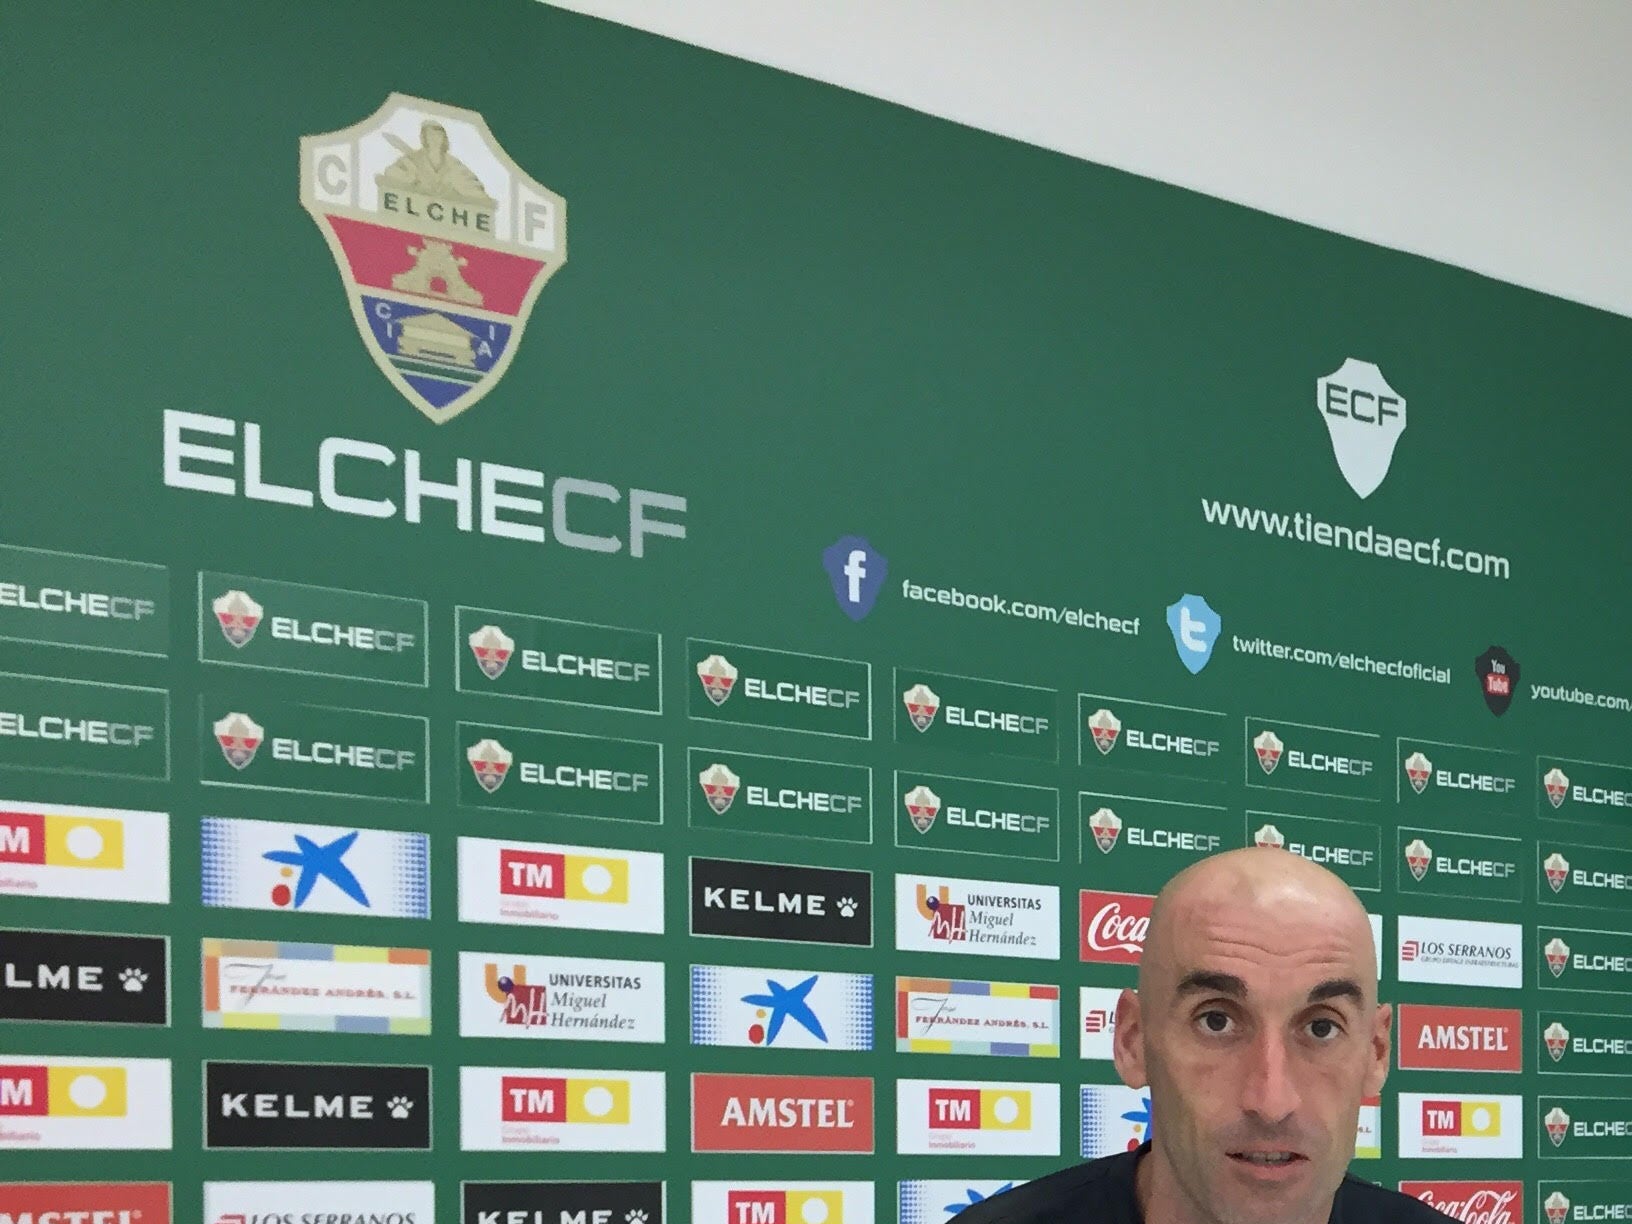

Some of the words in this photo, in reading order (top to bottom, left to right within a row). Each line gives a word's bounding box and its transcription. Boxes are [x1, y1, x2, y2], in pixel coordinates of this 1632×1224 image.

[384, 192, 491, 233] ELCHE
[1326, 383, 1400, 426] ECF
[164, 409, 687, 558] ELCHECF
[1202, 499, 1511, 579] www.tiendaecf.com
[0, 583, 155, 621] ELCHECF
[902, 579, 1141, 635] facebook.com/elchecf
[272, 617, 414, 652] ELCHECF
[522, 650, 650, 682] ELCHECF
[1232, 635, 1452, 684] twitter.com/elchecfoficial
[1490, 658, 1506, 674] You
[745, 678, 859, 709] ELCHECF
[1487, 675, 1510, 694] Tube
[0, 712, 154, 747] ELCHECF
[946, 706, 1048, 735] ELCHECF
[272, 738, 415, 770] ELCHECF
[1126, 730, 1219, 757] ELCHECF
[1288, 751, 1373, 776] ELCHECF
[520, 763, 648, 792] ELCHECF
[1436, 770, 1515, 794] ELCHECF
[747, 787, 861, 814] ELCHECF
[947, 807, 1049, 834] ELCHECF
[0, 826, 30, 854] M
[1127, 828, 1220, 852] ELCHECF
[1289, 843, 1373, 866] ELCHECF
[1436, 857, 1515, 878] ELCHECF
[508, 861, 553, 889] TM
[704, 887, 826, 915] KELME
[968, 894, 1041, 910] UNIVERSITAS
[969, 911, 1014, 929] Miguel
[969, 929, 1037, 946] Hernández
[1421, 942, 1444, 955] LOS
[1448, 944, 1512, 959] SERRANOS
[6, 963, 103, 992] LME
[549, 973, 641, 990] UNIVERSITAS
[550, 992, 606, 1012] Miguel
[551, 1011, 635, 1030] Hernández
[1418, 1025, 1508, 1051] AMSTEL
[0, 1078, 32, 1106] M
[509, 1088, 554, 1114] TM
[221, 1093, 373, 1119] KELME
[721, 1097, 854, 1128] AMSTEL
[935, 1099, 971, 1121] TM
[1427, 1110, 1454, 1129] TM
[736, 1202, 775, 1224] TM
